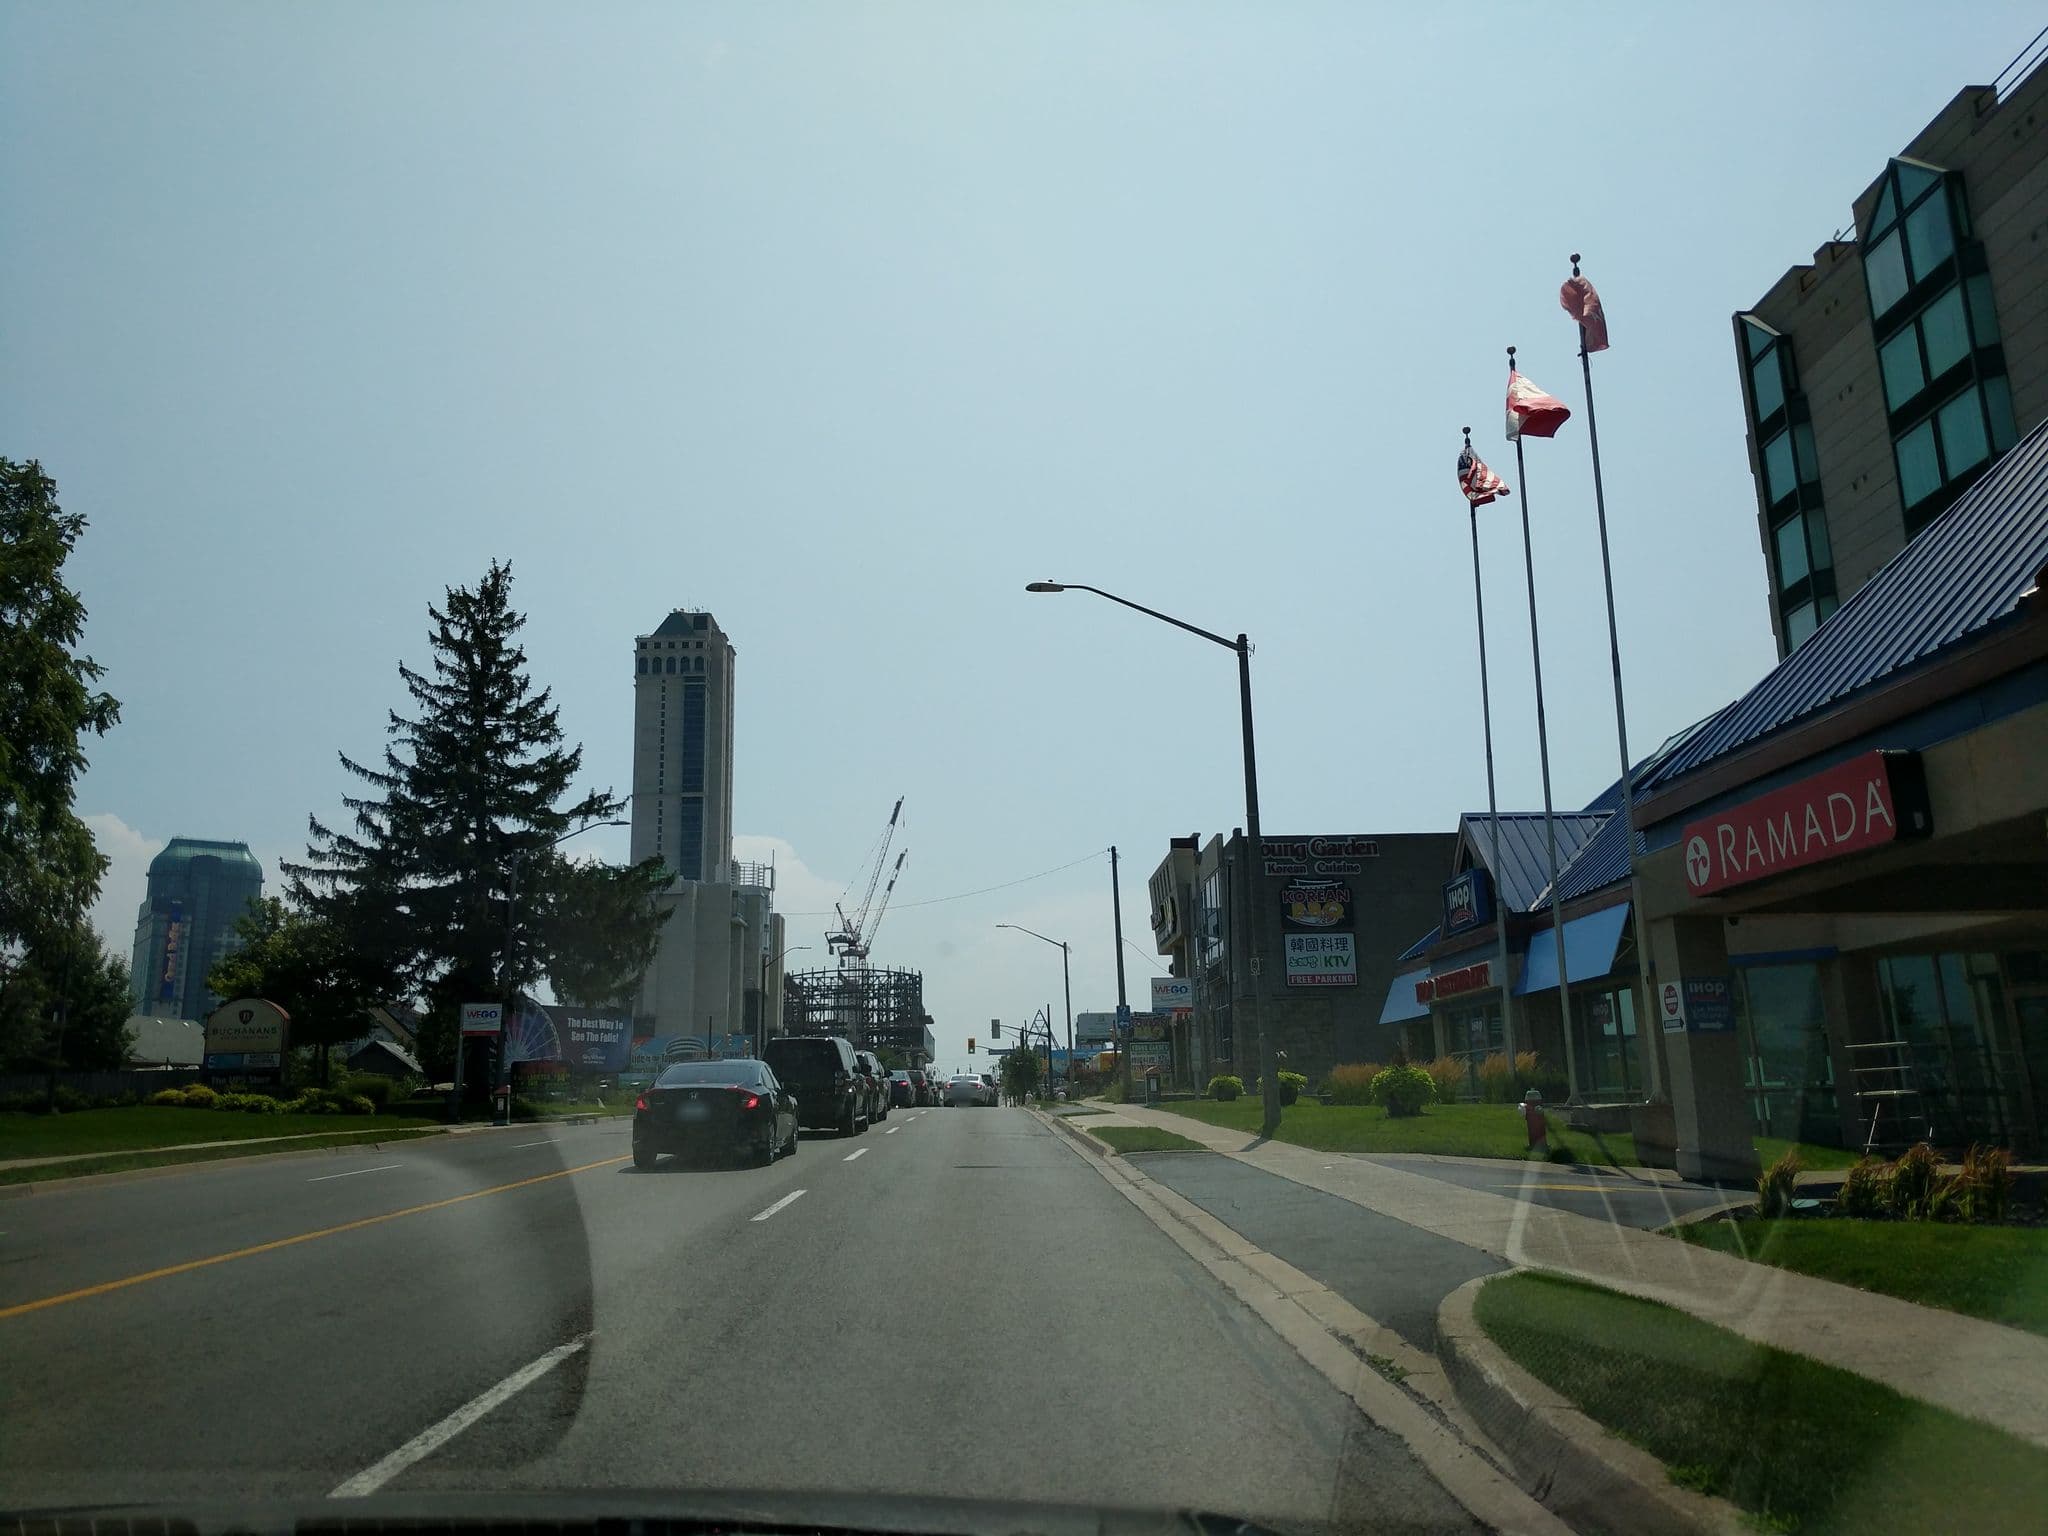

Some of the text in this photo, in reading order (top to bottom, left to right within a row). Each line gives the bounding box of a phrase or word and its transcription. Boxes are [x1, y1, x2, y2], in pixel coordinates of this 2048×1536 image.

[1717, 780, 1893, 879] RAMADA
[1261, 837, 1380, 863] oung Garden
[1265, 860, 1361, 875] Korean Cuisine
[1281, 889, 1351, 903] KOREAN
[1448, 884, 1469, 910] IHOP
[1290, 937, 1349, 952] 韓國料理
[1324, 953, 1351, 967] KTV
[1291, 974, 1353, 984] FREE PARKING
[1154, 985, 1188, 994] WEGO
[466, 1010, 497, 1018] WEGO
[567, 1017, 623, 1030] The Best Way To
[212, 1027, 277, 1035] BUCHANANS
[571, 1031, 619, 1043] See The Falls!
